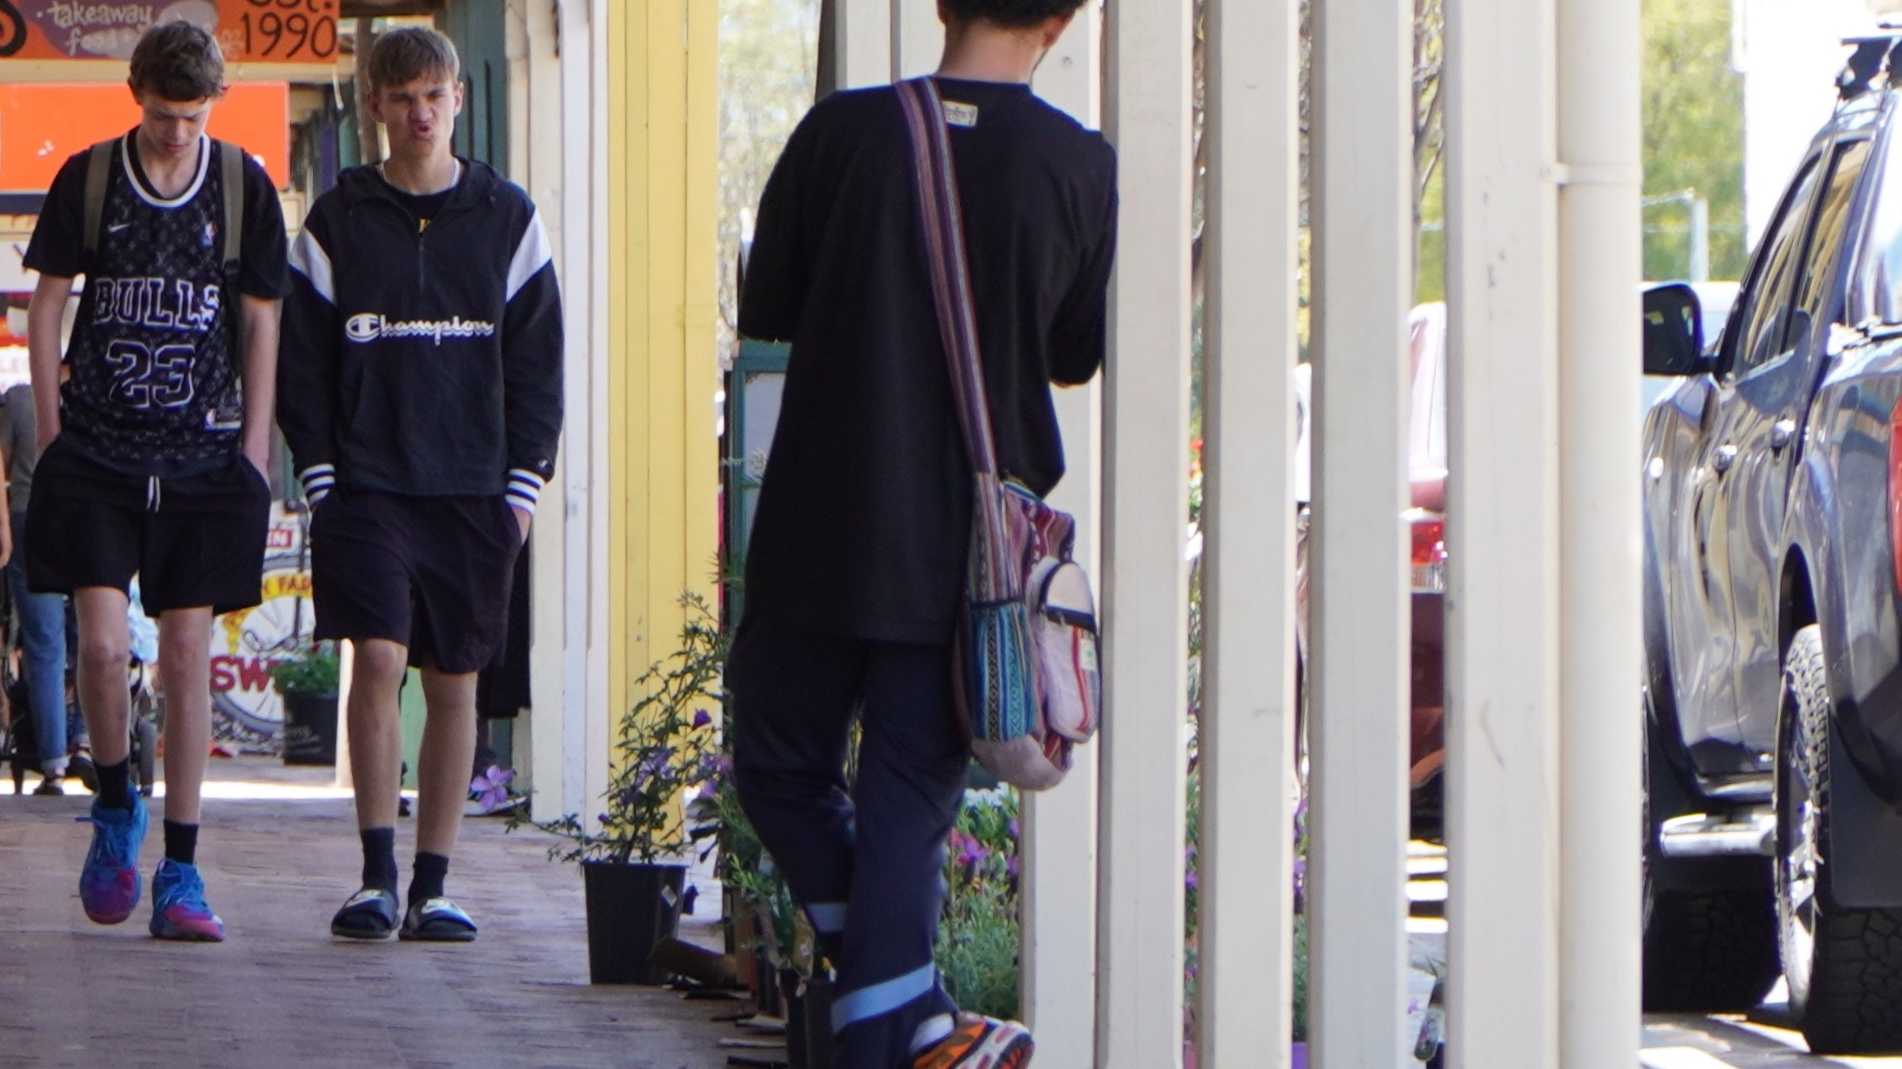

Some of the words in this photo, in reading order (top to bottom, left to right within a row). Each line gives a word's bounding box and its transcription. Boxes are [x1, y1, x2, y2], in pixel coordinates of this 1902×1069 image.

[47, 0, 154, 34] takeaway
[241, 11, 338, 59] 1990
[92, 277, 221, 332] BULLS
[345, 312, 495, 346] Champion
[105, 339, 196, 409] 23
